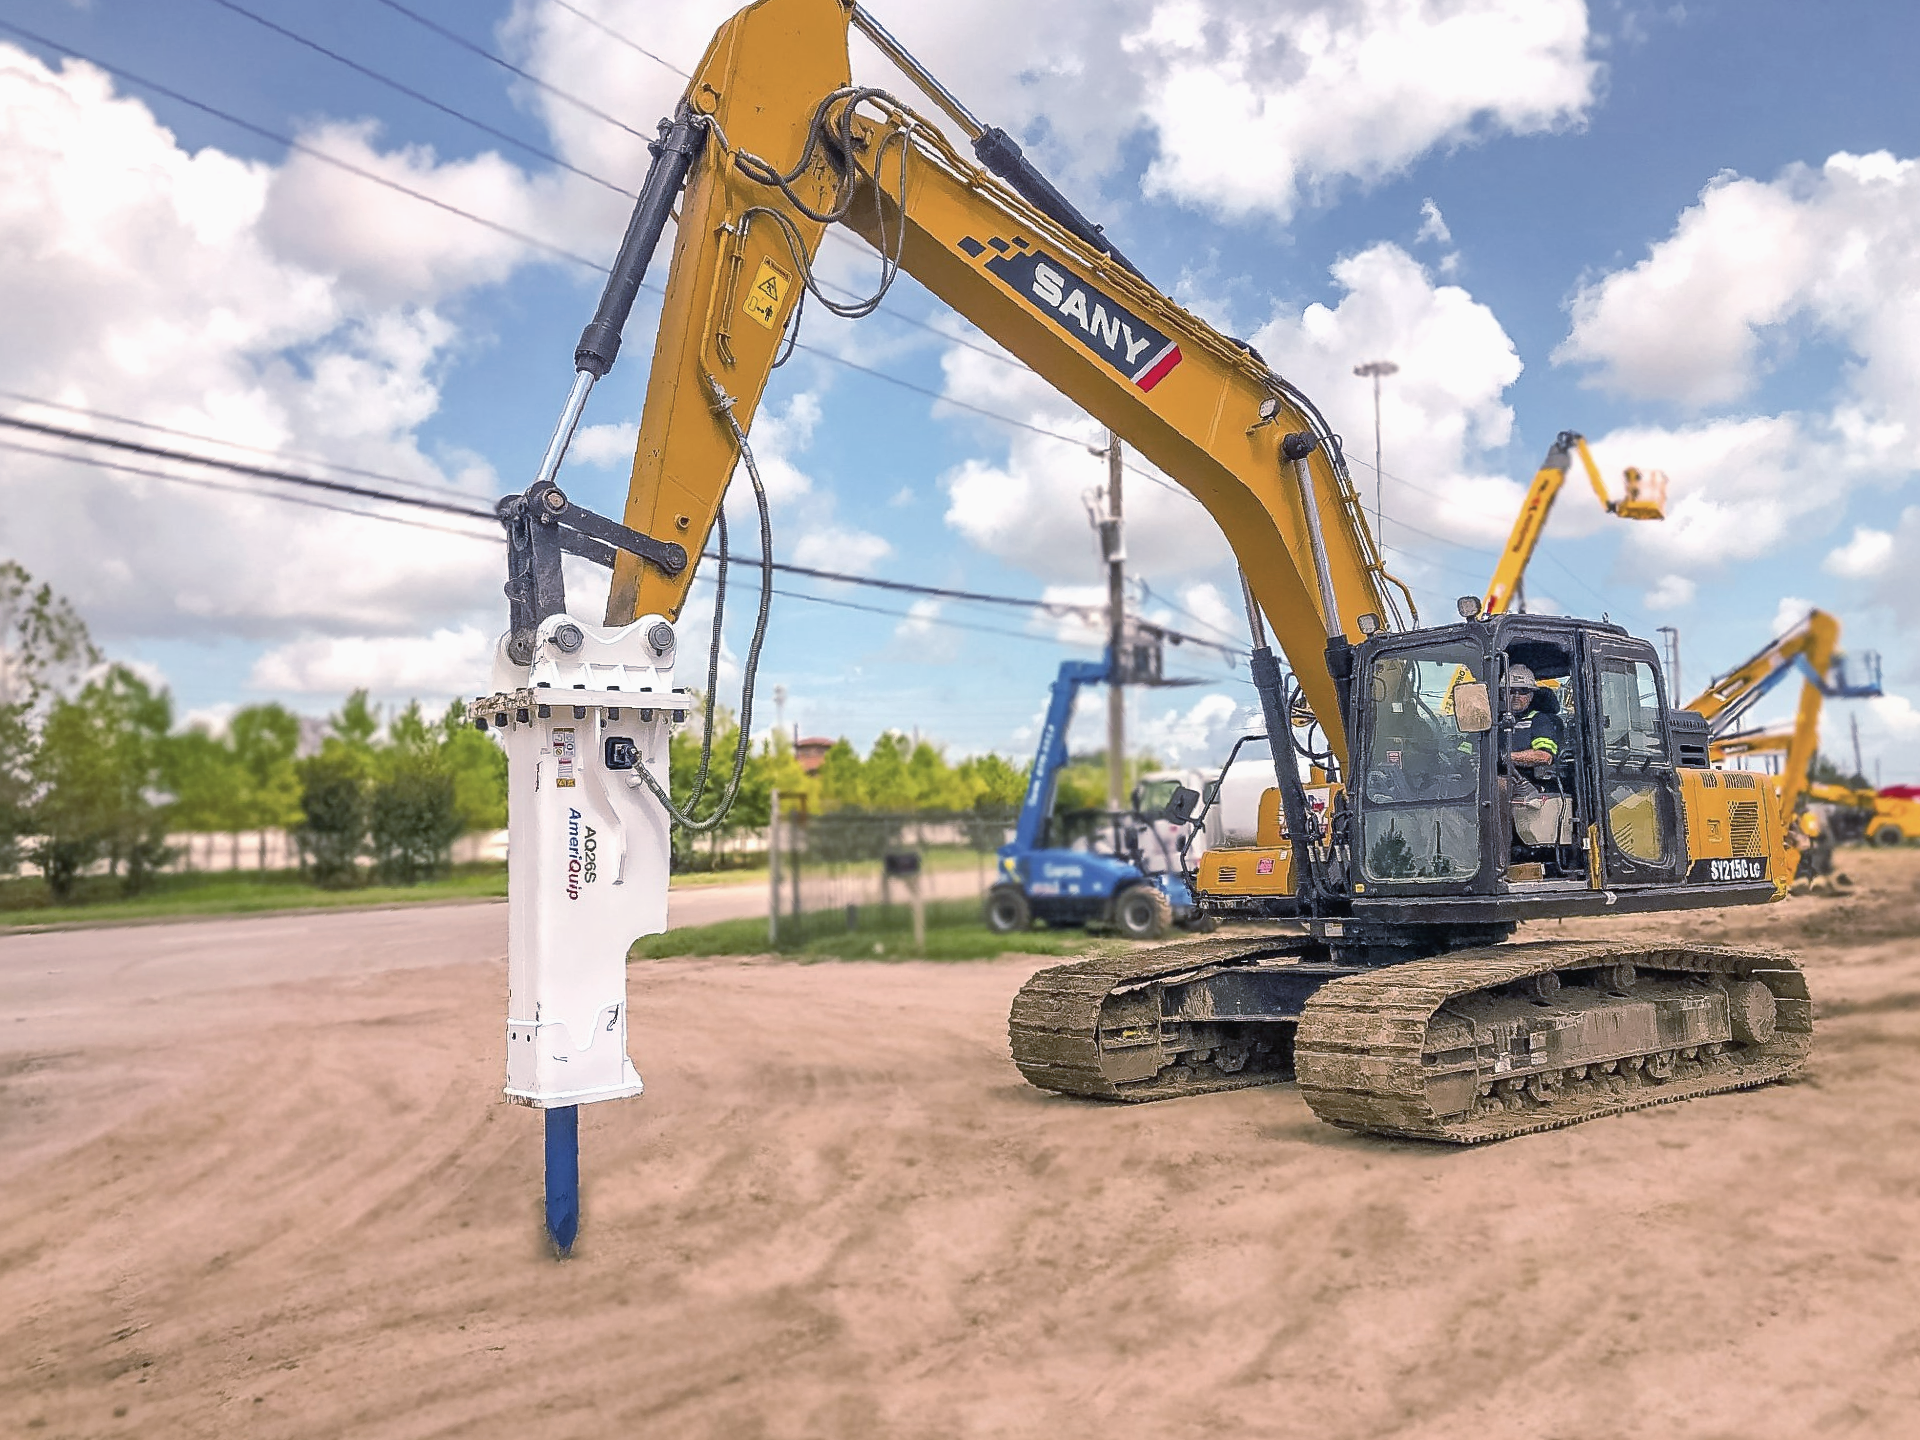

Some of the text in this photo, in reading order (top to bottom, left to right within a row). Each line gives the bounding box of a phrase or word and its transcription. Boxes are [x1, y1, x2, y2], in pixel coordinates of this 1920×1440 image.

[1032, 262, 1150, 365] SANY
[566, 807, 582, 901] AmeriQuip
[584, 825, 597, 884] AQ26S
[1711, 859, 1761, 880] SY215C LC
